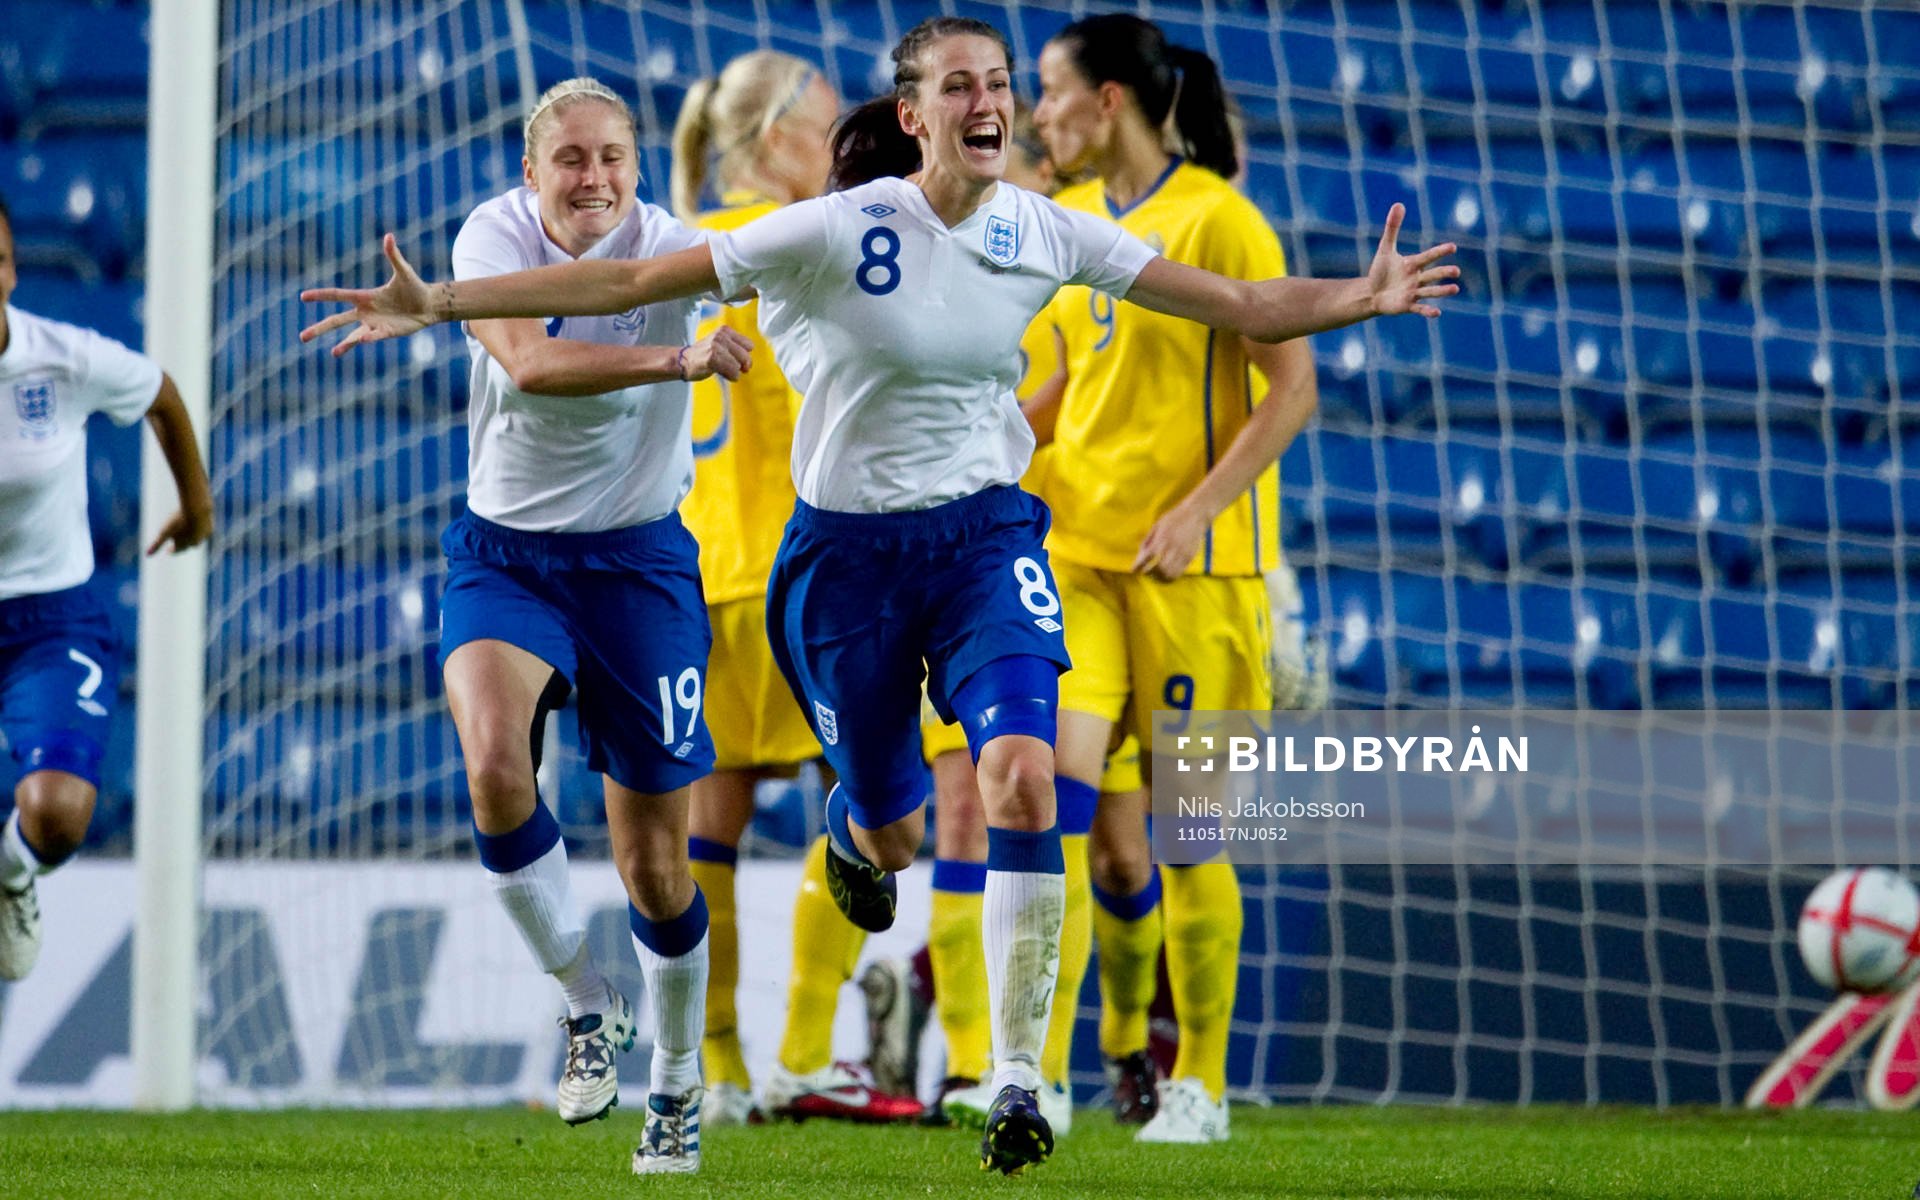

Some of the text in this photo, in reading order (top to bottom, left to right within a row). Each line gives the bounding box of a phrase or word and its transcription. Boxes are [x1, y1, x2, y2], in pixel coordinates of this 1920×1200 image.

[855, 226, 902, 296] 8
[1089, 288, 1115, 352] 9
[1013, 556, 1060, 617] 8
[68, 648, 103, 699] 7
[1161, 673, 1196, 735] 9
[658, 666, 701, 746] 19
